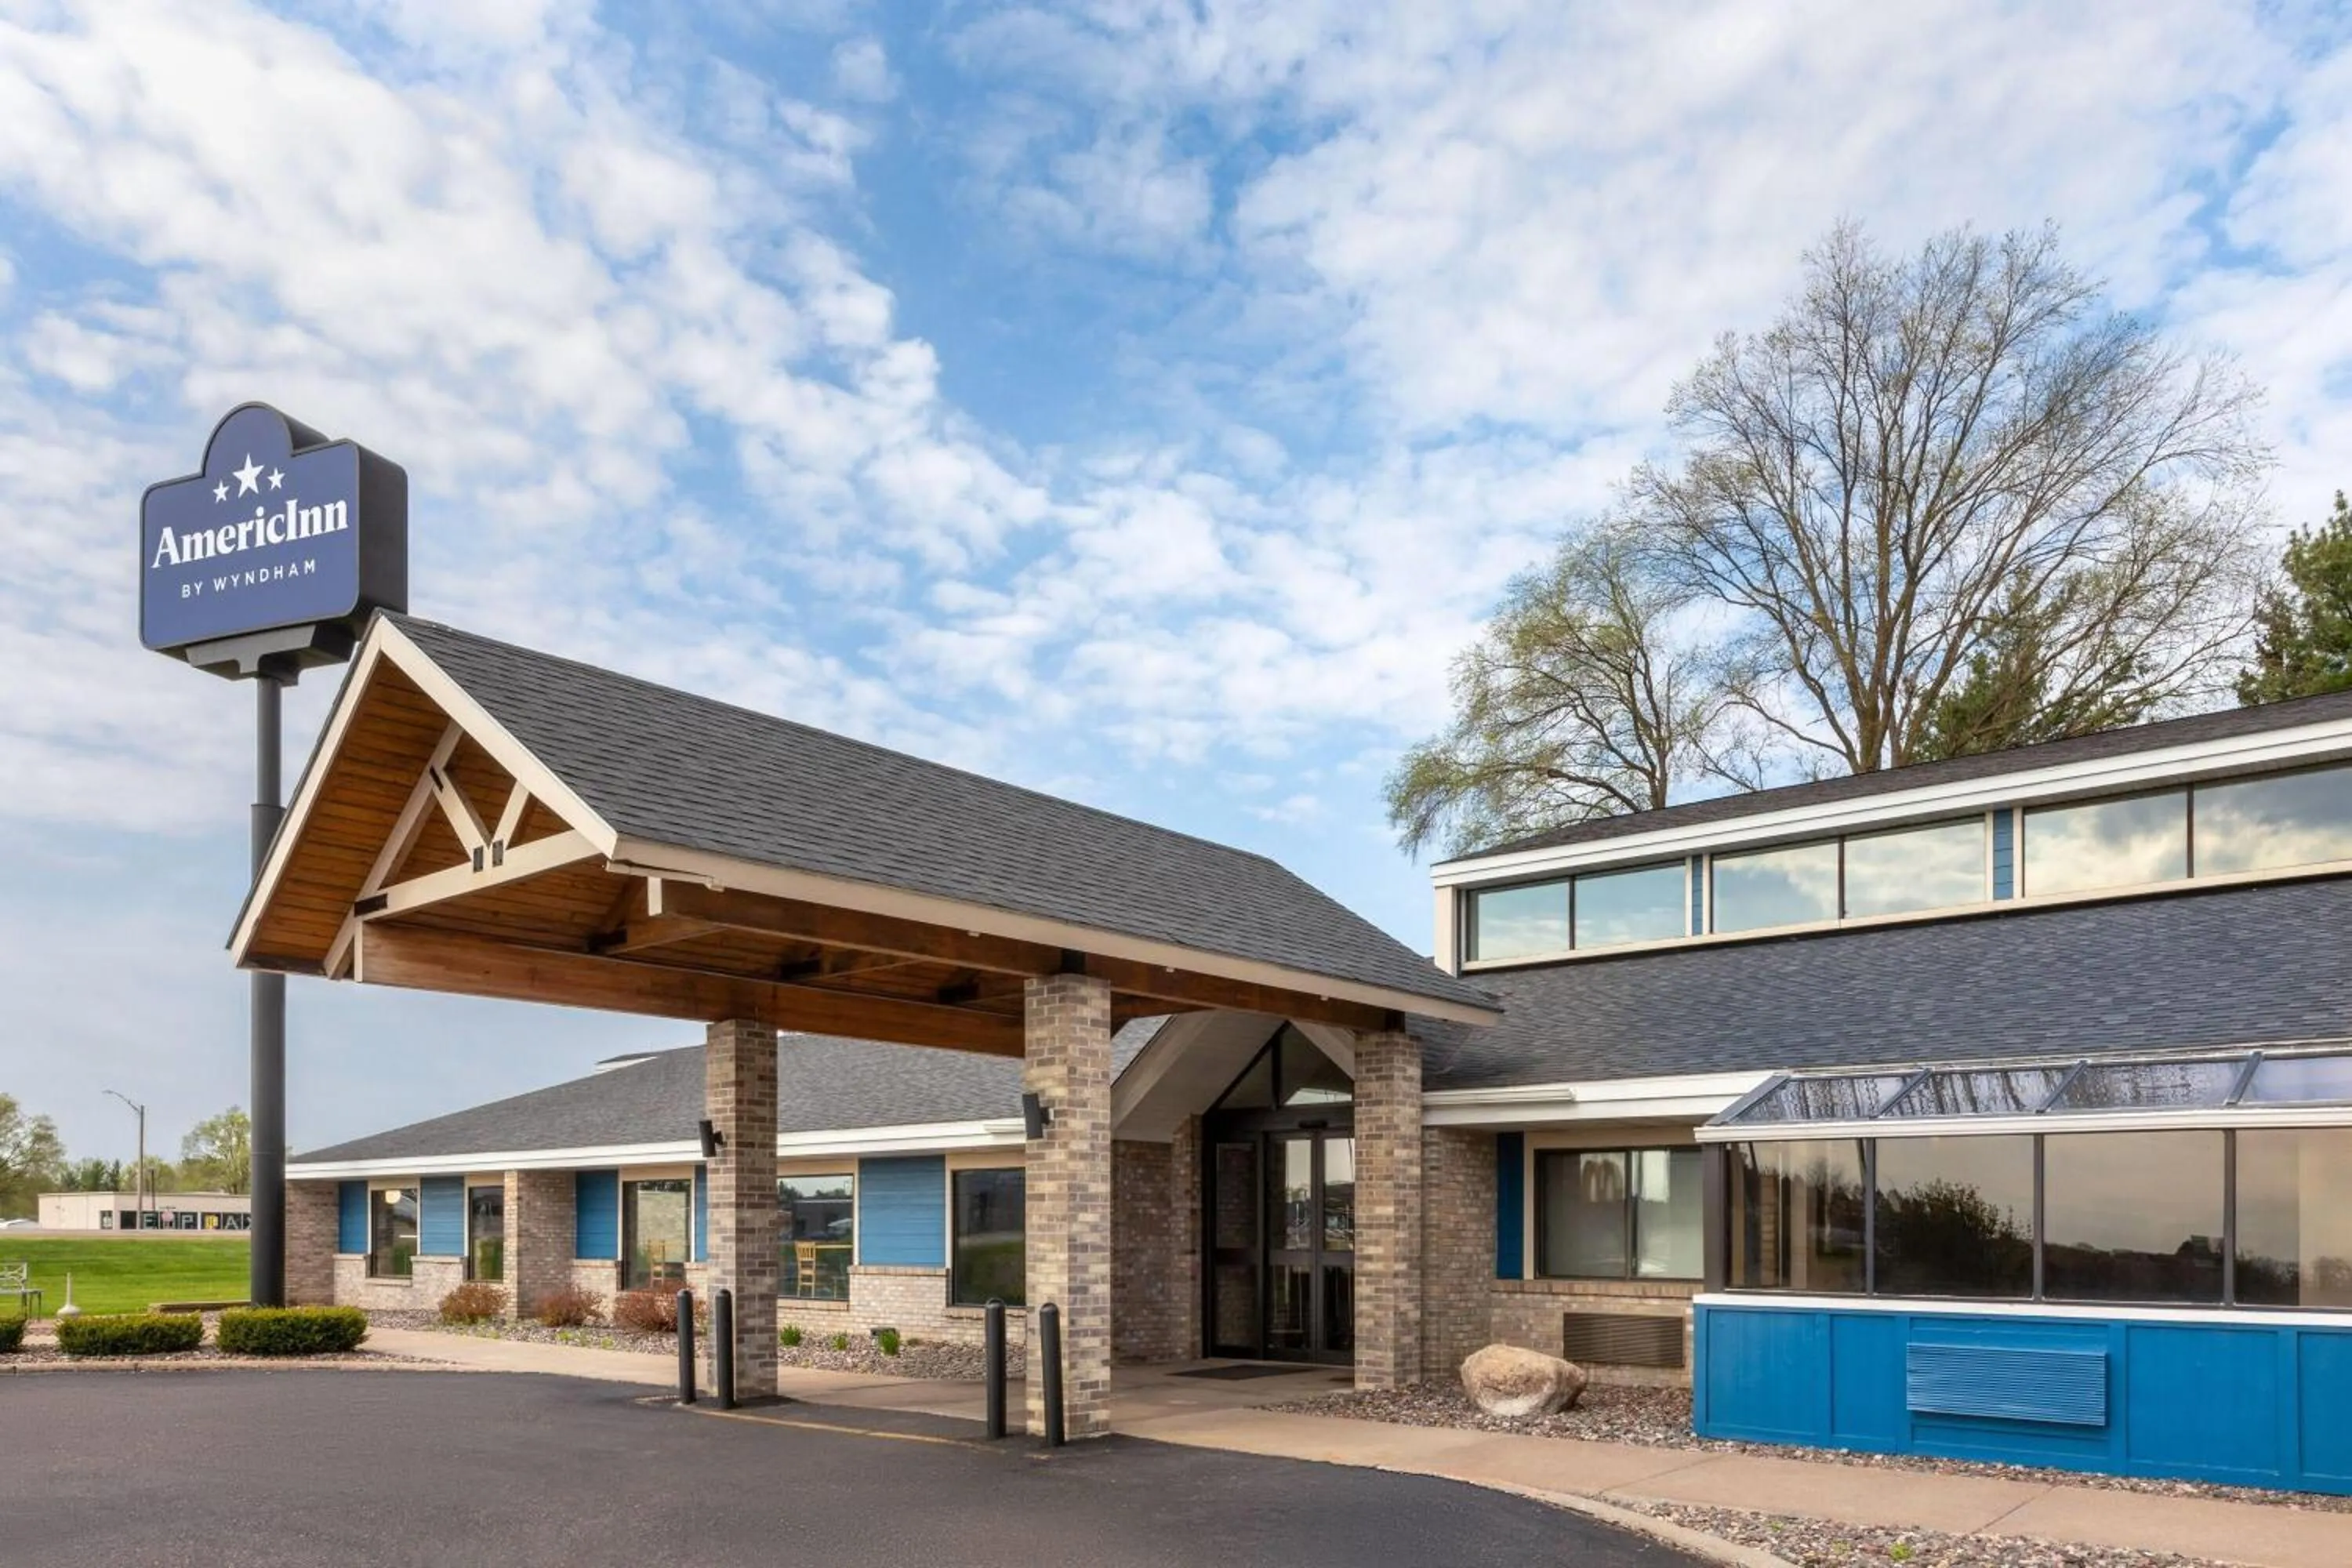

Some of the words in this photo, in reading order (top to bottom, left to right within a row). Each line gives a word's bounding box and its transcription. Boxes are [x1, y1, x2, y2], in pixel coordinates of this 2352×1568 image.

[151, 499, 349, 568] AmericInn
[181, 584, 203, 598] BY
[214, 559, 317, 593] WYNDHAM
